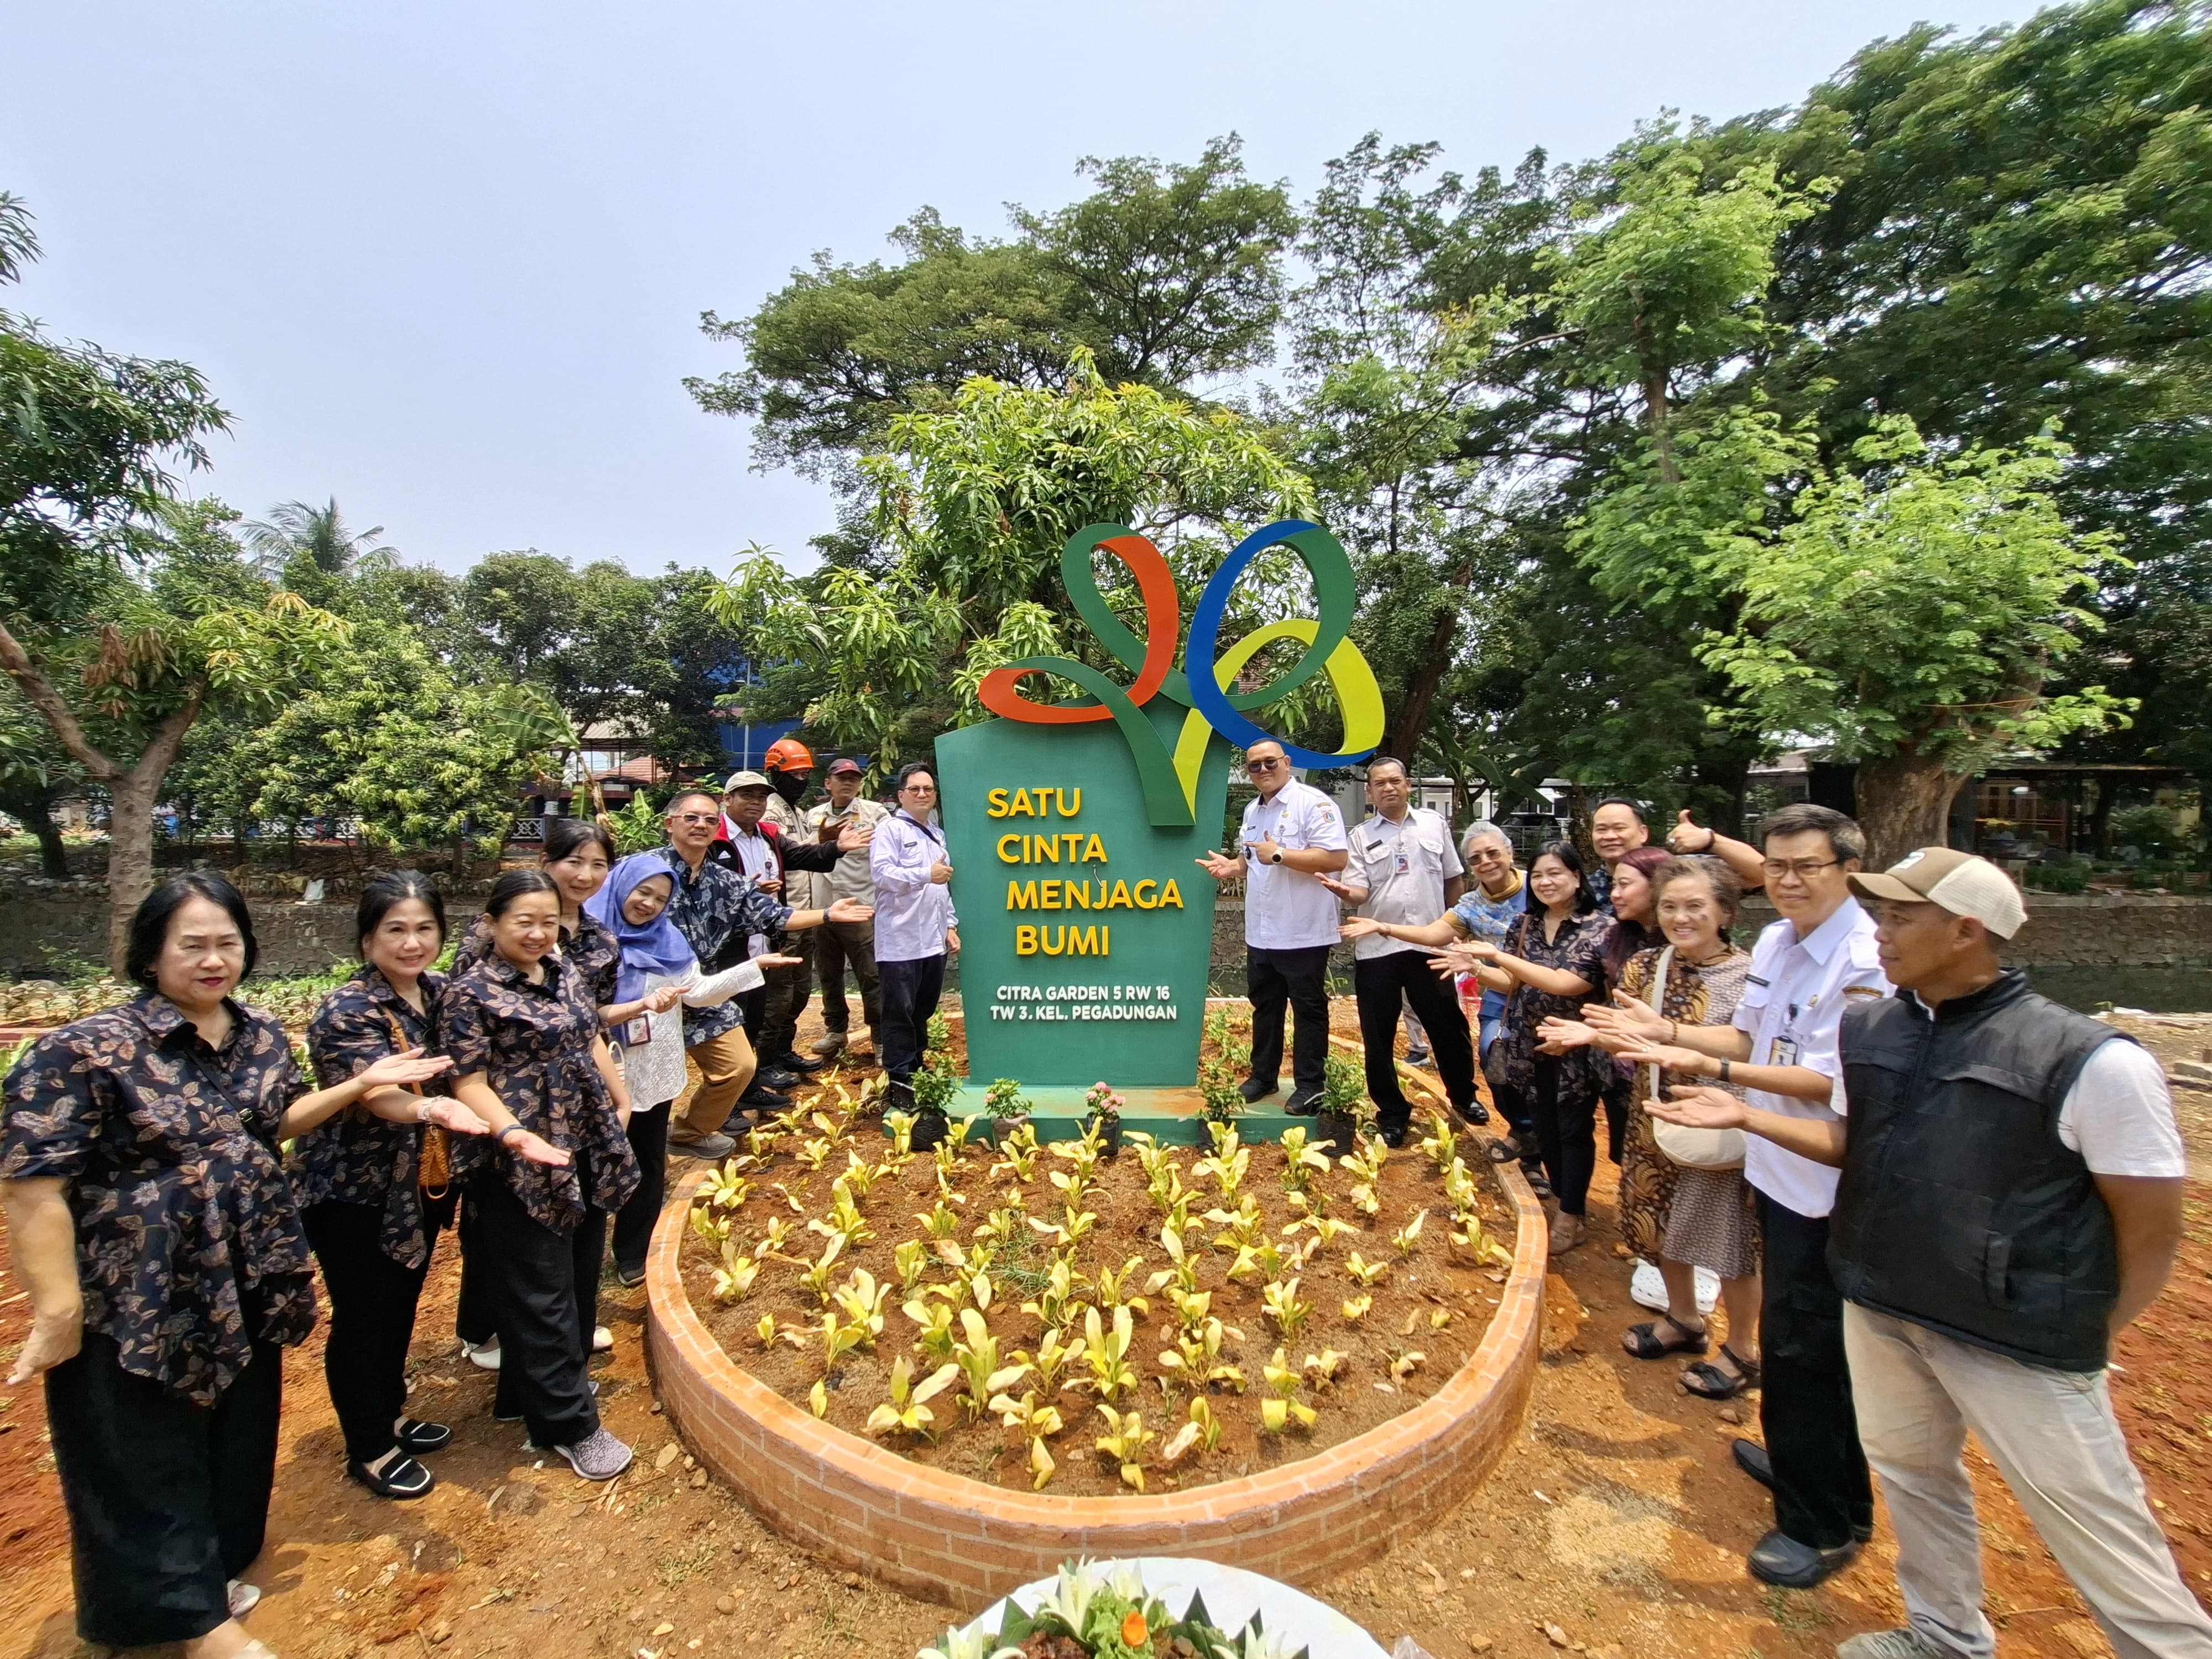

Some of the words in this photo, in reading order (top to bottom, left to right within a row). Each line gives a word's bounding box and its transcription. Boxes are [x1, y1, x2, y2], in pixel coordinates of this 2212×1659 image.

[988, 787, 1081, 817] SATU
[997, 833, 1108, 863] CINTA
[1006, 879, 1183, 910] MENJAGA
[1016, 925, 1109, 956] BUMI
[997, 985, 1042, 1000] CITRA
[1045, 985, 1108, 1001] GARDEN
[1113, 985, 1122, 1000] 5
[1125, 985, 1152, 1000] RW
[1155, 985, 1170, 1000] 16
[990, 1005, 1016, 1020] TW
[1072, 1004, 1177, 1020] PEGADUNGAN
